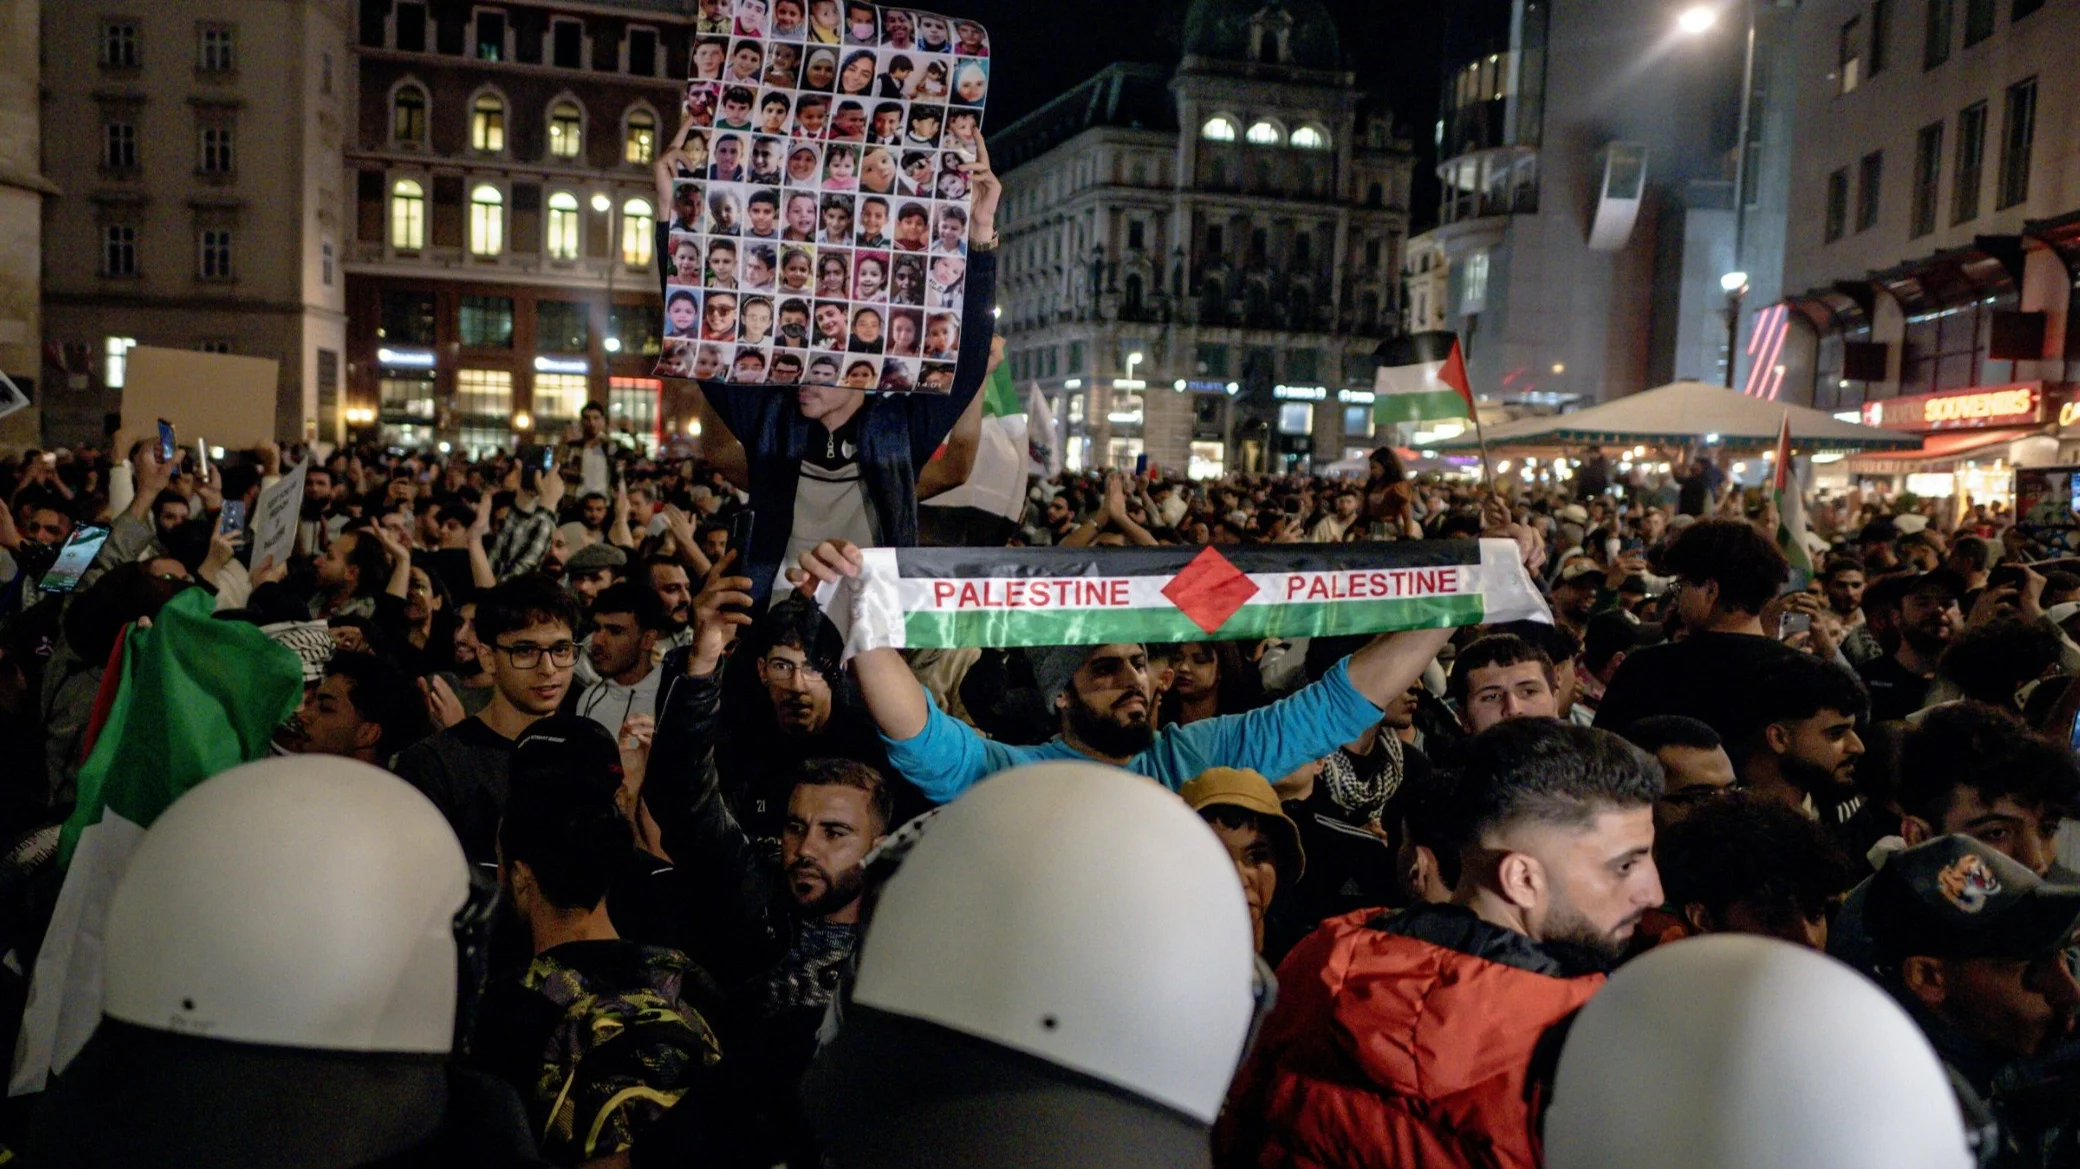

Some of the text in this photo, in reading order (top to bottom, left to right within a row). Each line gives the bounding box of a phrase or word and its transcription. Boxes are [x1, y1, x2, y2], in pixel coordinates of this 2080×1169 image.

[1924, 388, 2031, 422] SOUVENIRS
[934, 569, 1458, 608] PALESTINE PALESTINE
[756, 799, 766, 813] 21
